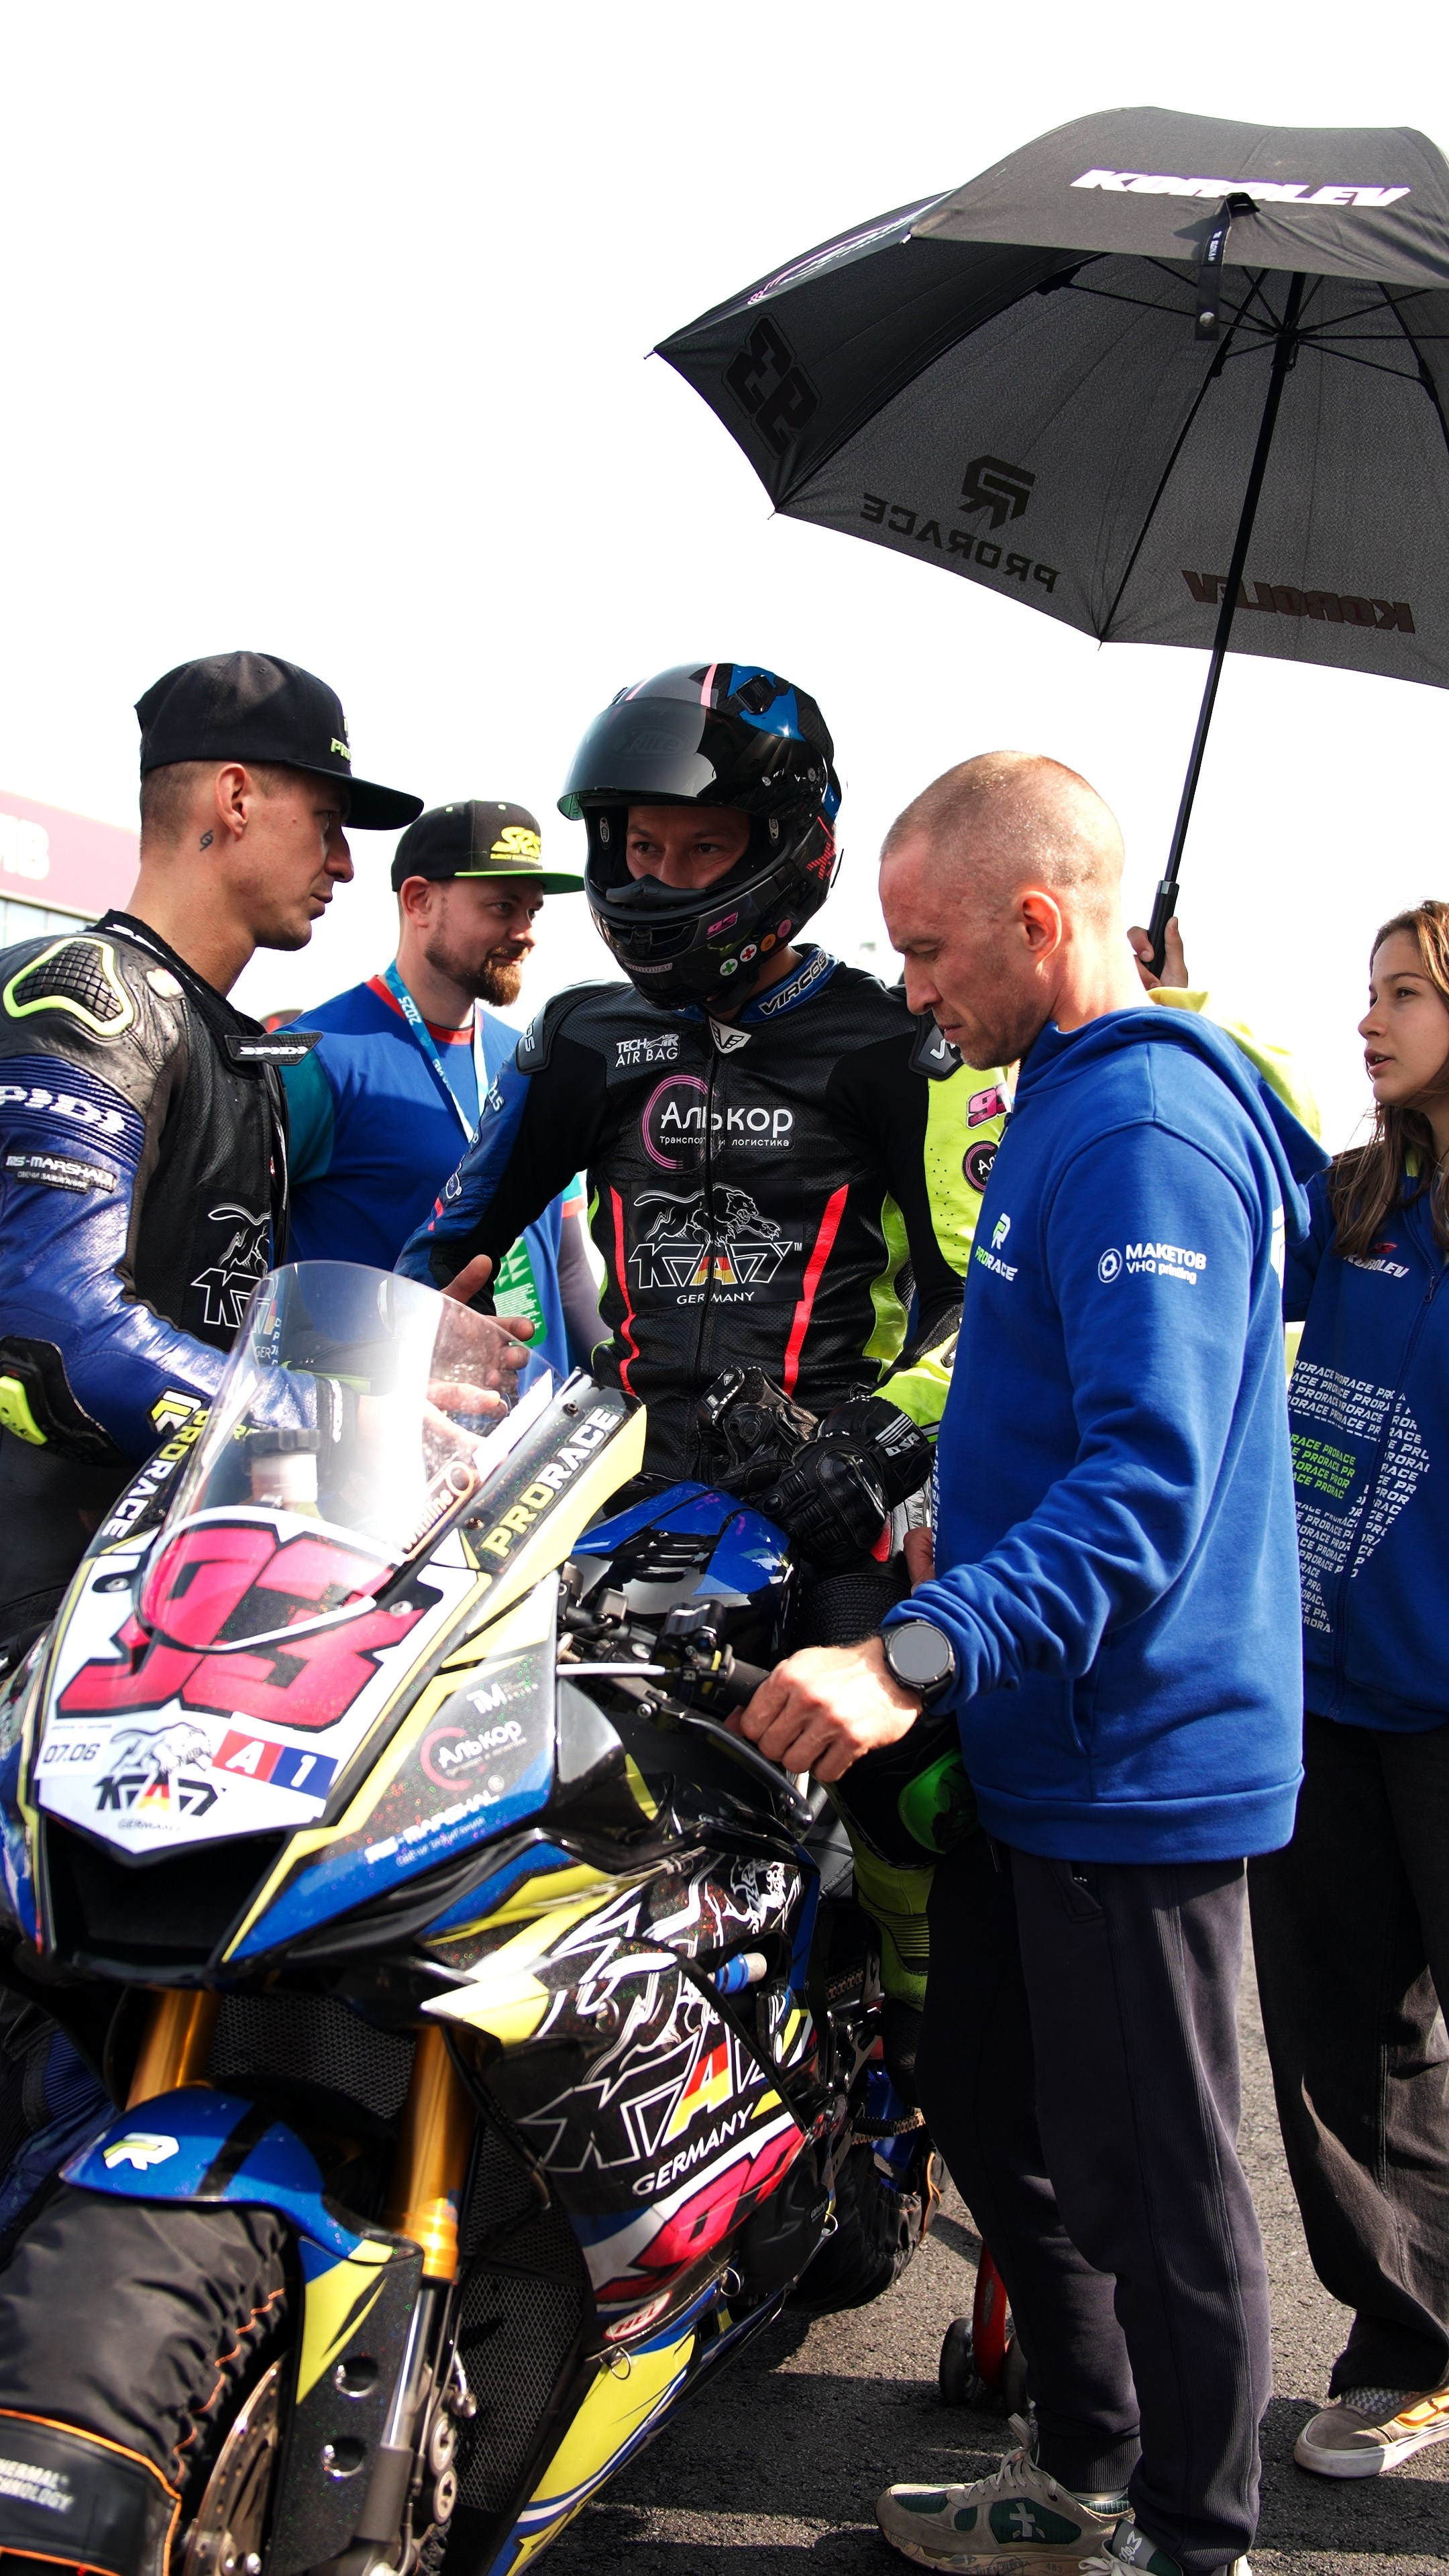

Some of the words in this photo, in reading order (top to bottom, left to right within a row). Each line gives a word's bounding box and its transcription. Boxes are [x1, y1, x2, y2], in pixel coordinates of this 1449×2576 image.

[1071, 170, 1411, 207] KOROLEV
[758, 951, 829, 1015] VIRCOS
[398, 996, 421, 1026] 2025
[239, 1046, 309, 1055] SPIDI
[615, 1051, 640, 1067] AIR
[646, 1047, 678, 1061] BAG
[661, 1102, 793, 1138] Алькор
[732, 1139, 790, 1147] логистика
[975, 1245, 1018, 1282] PRORACE
[1126, 1242, 1207, 1271] MAKETOB
[1126, 1262, 1157, 1274] VHQ
[677, 1291, 755, 1304] GERMANY
[480, 1407, 620, 1558] PRORACE
[57, 1521, 426, 1733] 93
[43, 1743, 100, 1765] 07.06
[632, 2103, 754, 2195] GERMANY
[614, 2302, 656, 2334] HEL
